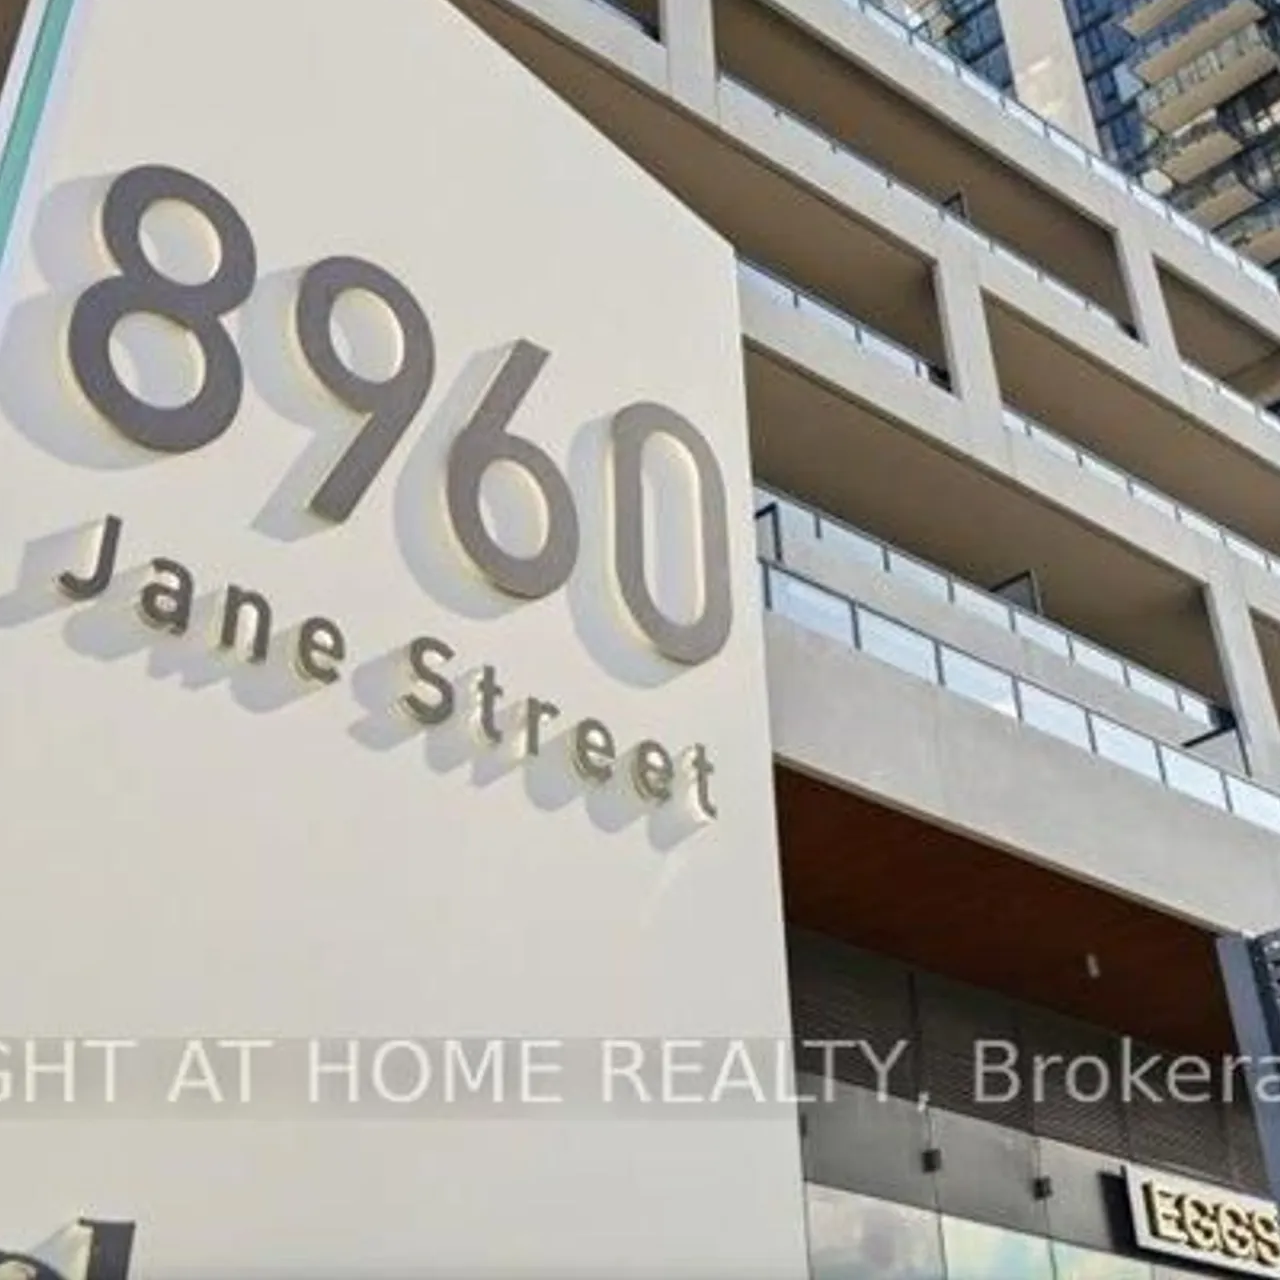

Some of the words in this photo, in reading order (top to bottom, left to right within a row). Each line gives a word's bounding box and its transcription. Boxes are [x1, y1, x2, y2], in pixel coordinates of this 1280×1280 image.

[66, 163, 734, 666] 8960
[55, 513, 347, 685] Jane
[399, 635, 718, 821] Street
